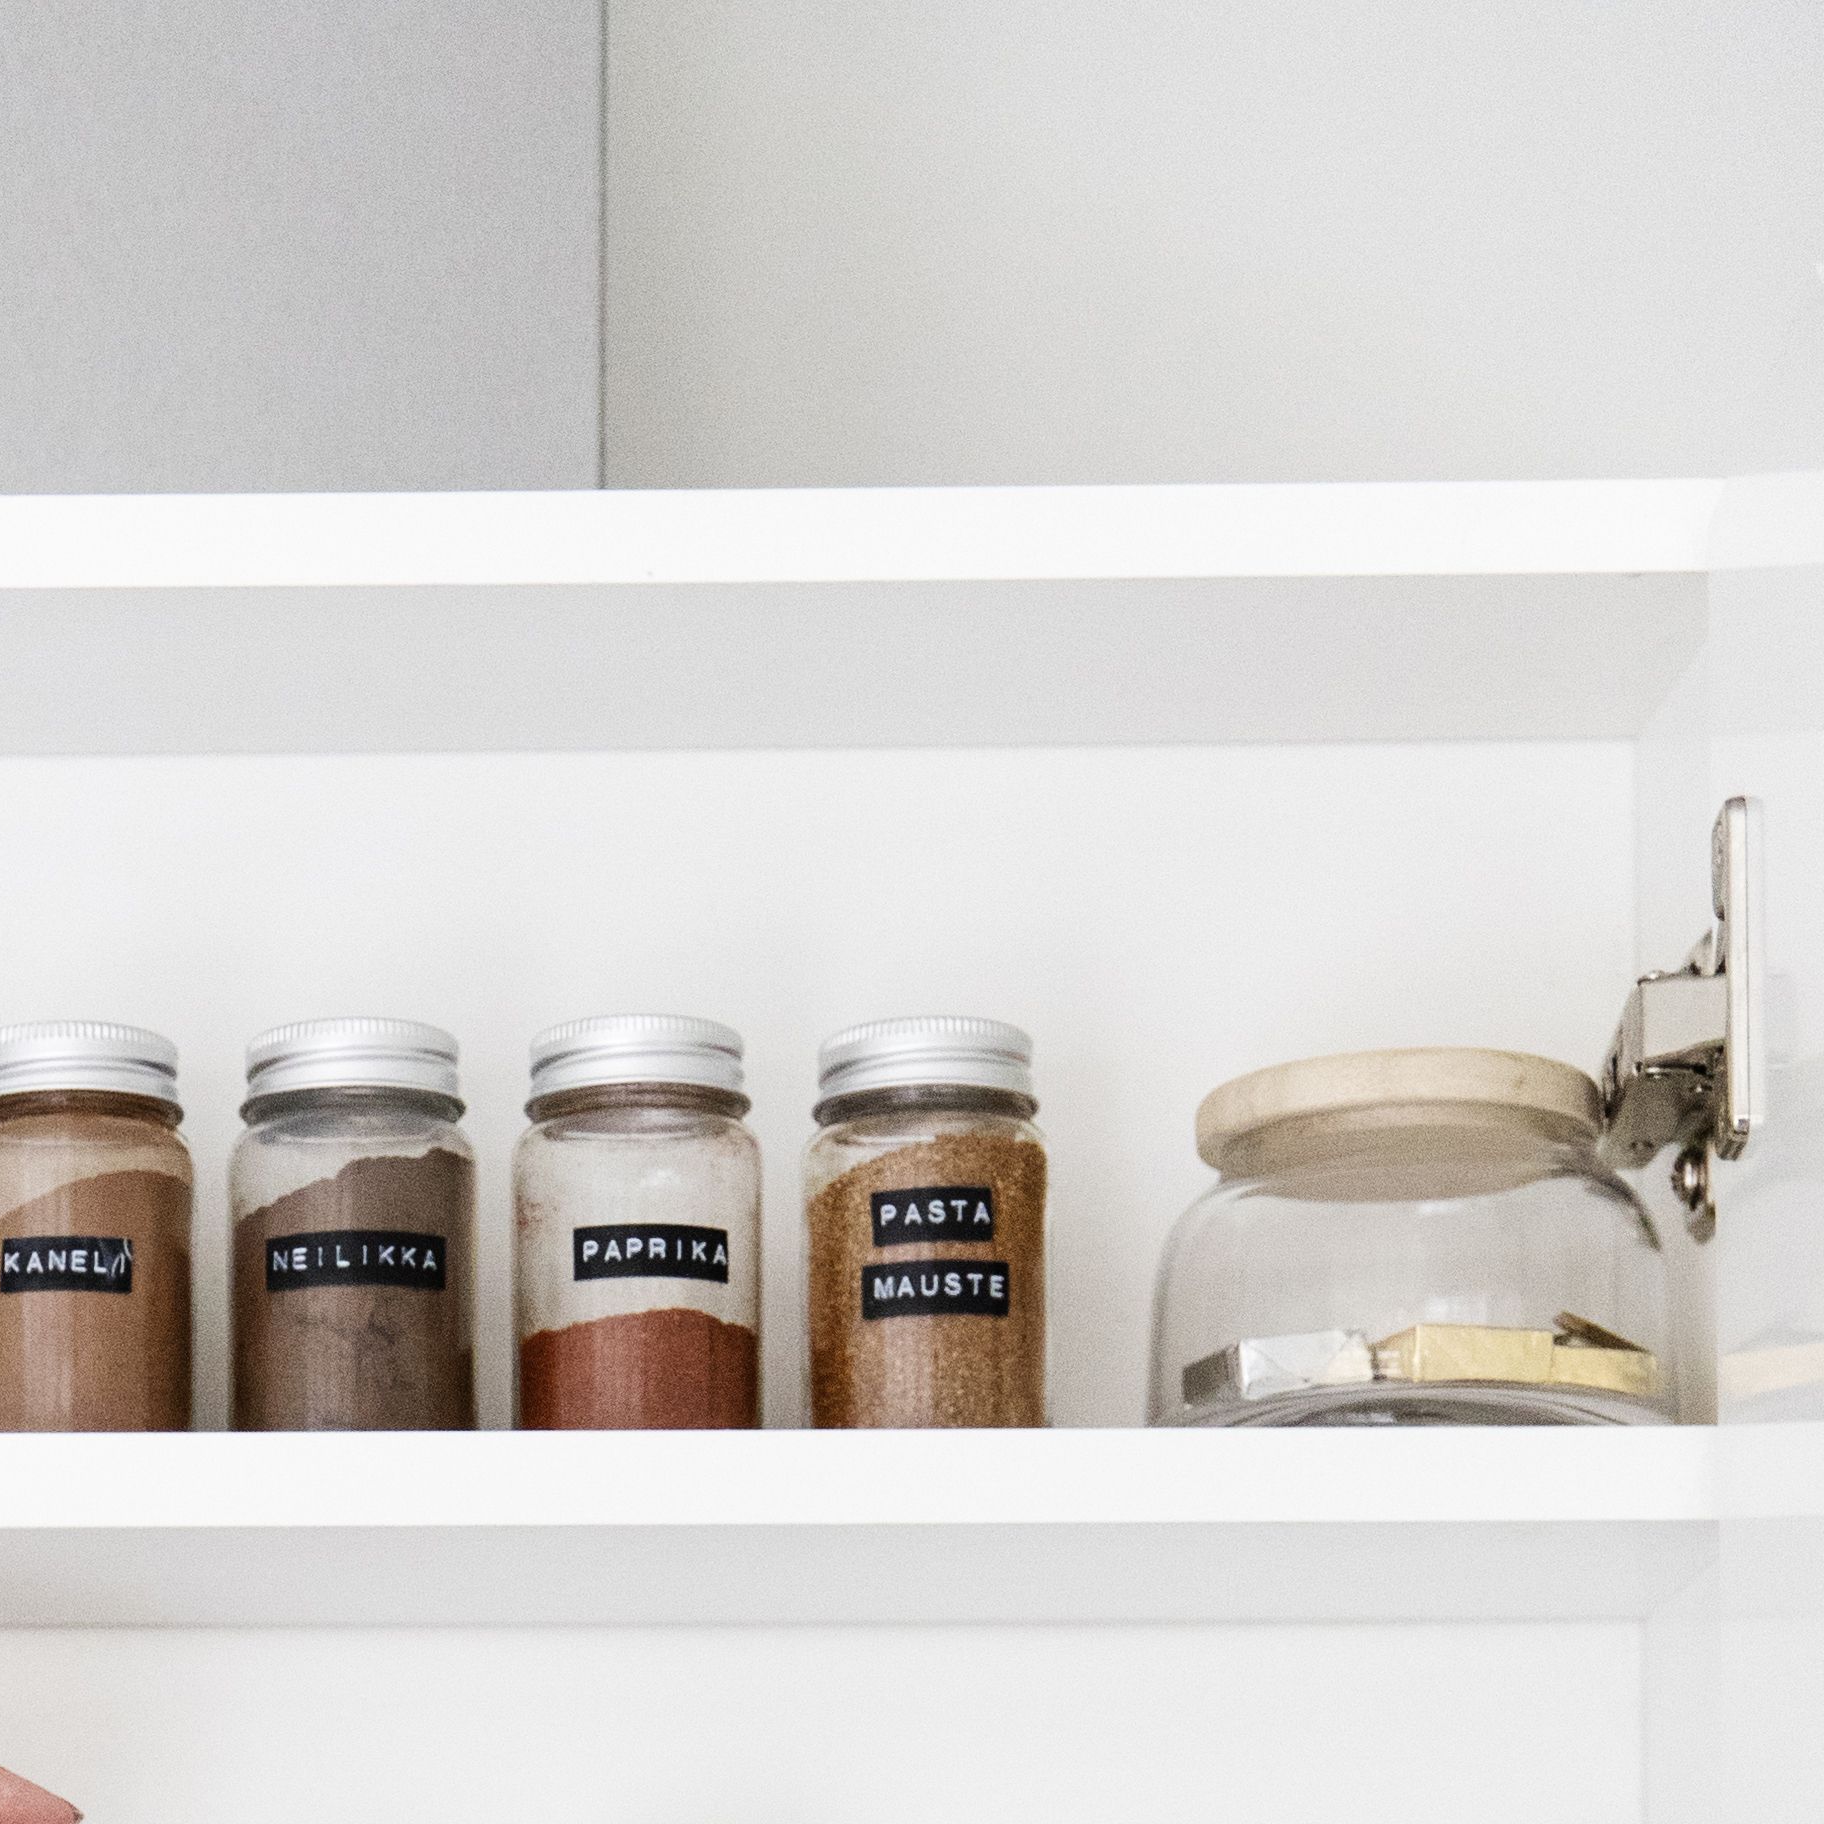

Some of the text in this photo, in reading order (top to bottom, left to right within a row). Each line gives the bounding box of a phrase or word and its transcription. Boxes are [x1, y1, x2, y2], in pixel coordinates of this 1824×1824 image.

[880, 1200, 991, 1227] PASTA
[272, 1246, 439, 1272] NEILIKKA
[582, 1237, 728, 1266] PAPRIKA
[874, 1273, 1006, 1300] MAUSTE
